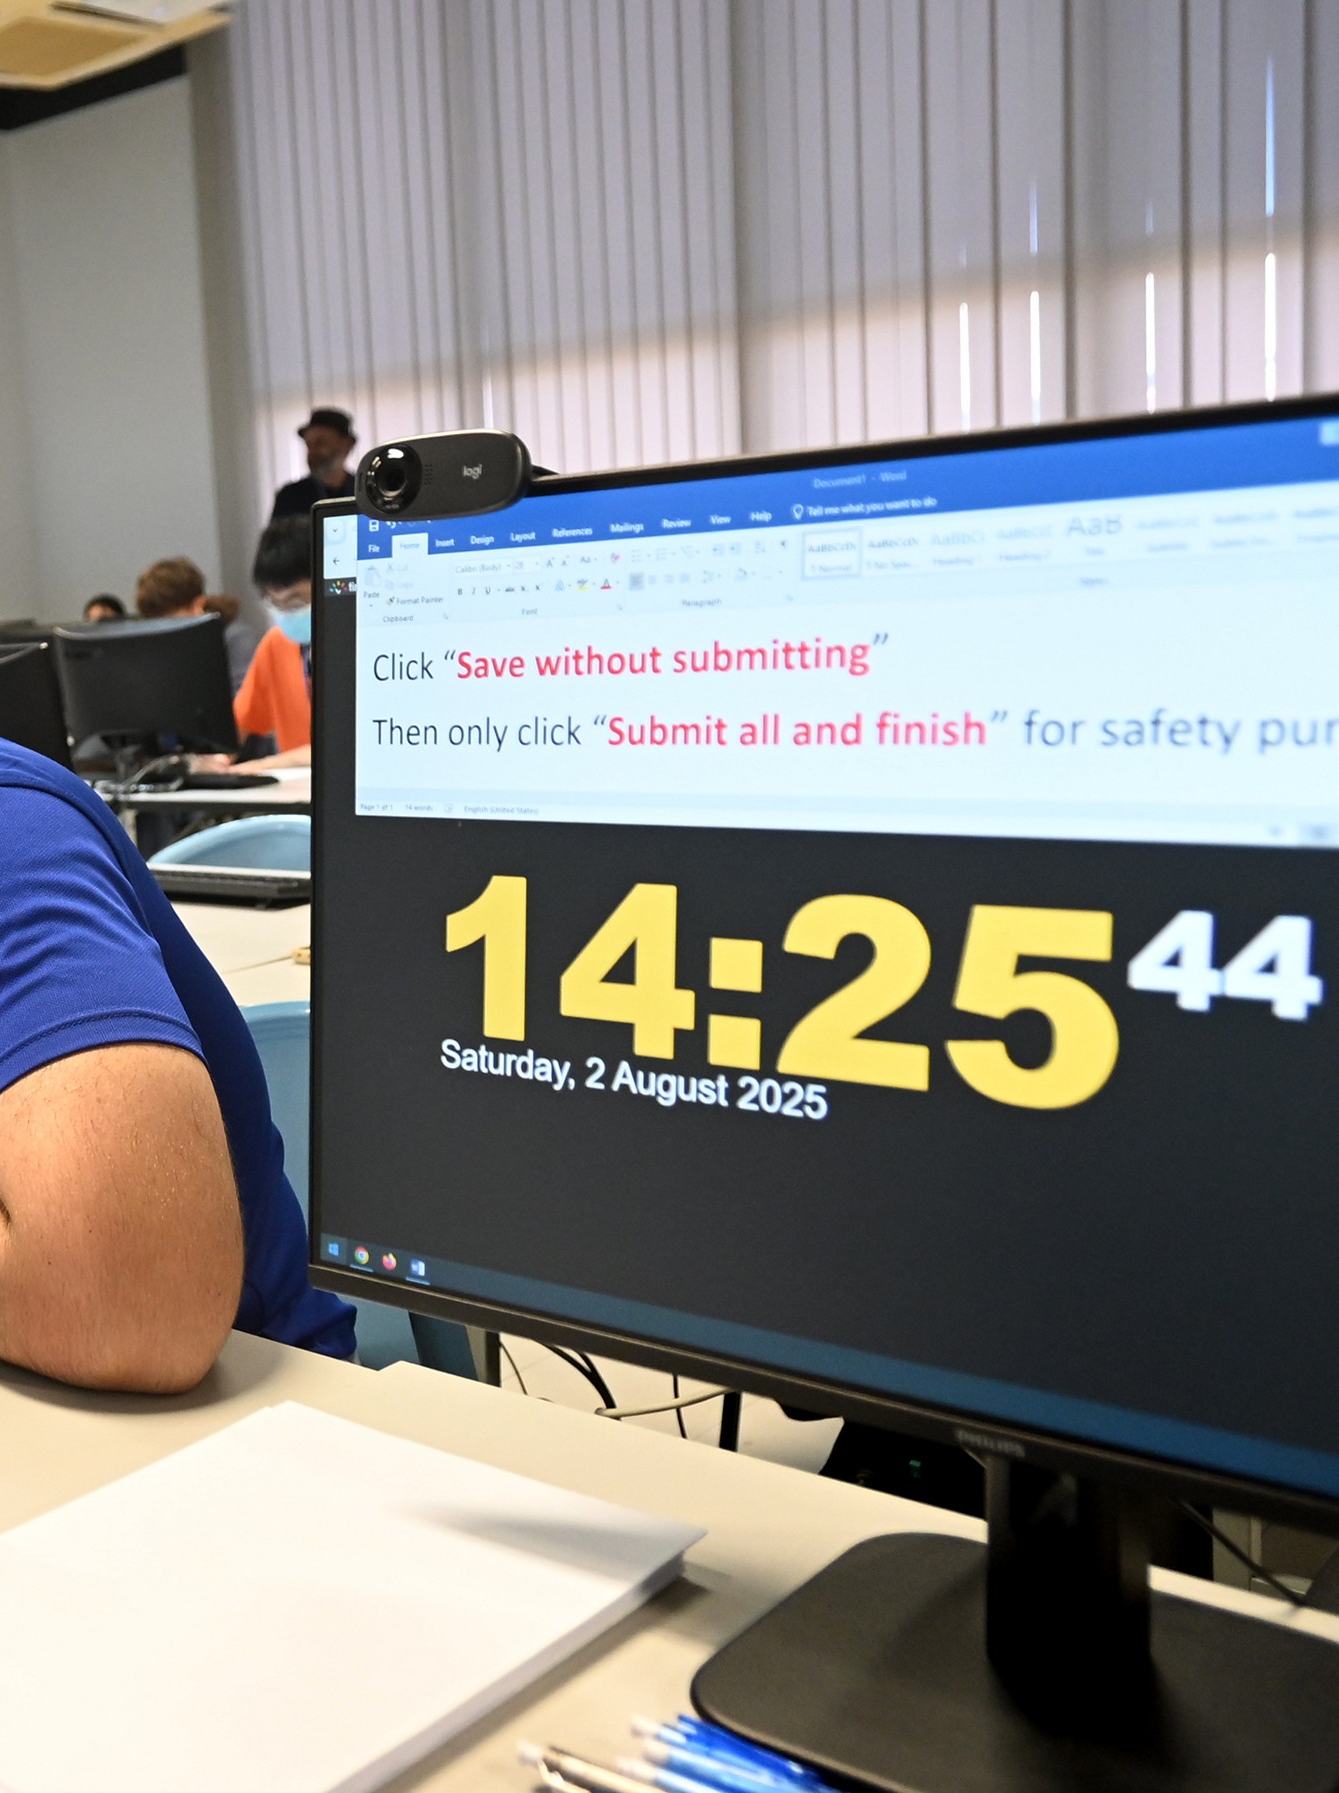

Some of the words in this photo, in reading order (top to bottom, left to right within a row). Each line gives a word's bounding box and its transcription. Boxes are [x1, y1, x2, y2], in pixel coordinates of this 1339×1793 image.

[462, 463, 483, 480] logi
[808, 505, 823, 517] Tell
[824, 506, 839, 516] me
[841, 502, 864, 514] what
[865, 502, 884, 515] you
[886, 498, 909, 510] want
[910, 498, 922, 508] to
[923, 496, 938, 507] do
[368, 544, 380, 553] File
[399, 542, 420, 550] Home
[435, 538, 455, 548] Insert
[470, 534, 495, 546] Design
[510, 531, 536, 544] Layout
[552, 526, 593, 538] References
[610, 521, 644, 534] Mailings
[662, 518, 692, 529] Review
[710, 514, 731, 525] View
[749, 511, 773, 523] Help
[382, 614, 414, 624] Clipboard
[373, 652, 434, 682] Click
[444, 649, 526, 680] “Save
[536, 645, 662, 678] without
[672, 632, 890, 678] submitting”
[372, 717, 439, 747] Then
[448, 716, 506, 753] only
[517, 715, 581, 747] click
[593, 713, 728, 747] “Submit
[739, 713, 780, 747] all
[792, 712, 863, 747] and
[875, 709, 1008, 747] finish”
[1022, 708, 1087, 748] for
[1098, 707, 1243, 756] safety
[1126, 908, 1325, 1022] 44
[444, 874, 1121, 1111] 14:25
[440, 1036, 578, 1092] Saturday,
[585, 1054, 605, 1092] 2
[610, 1060, 729, 1110] August
[735, 1077, 830, 1121] 2025
